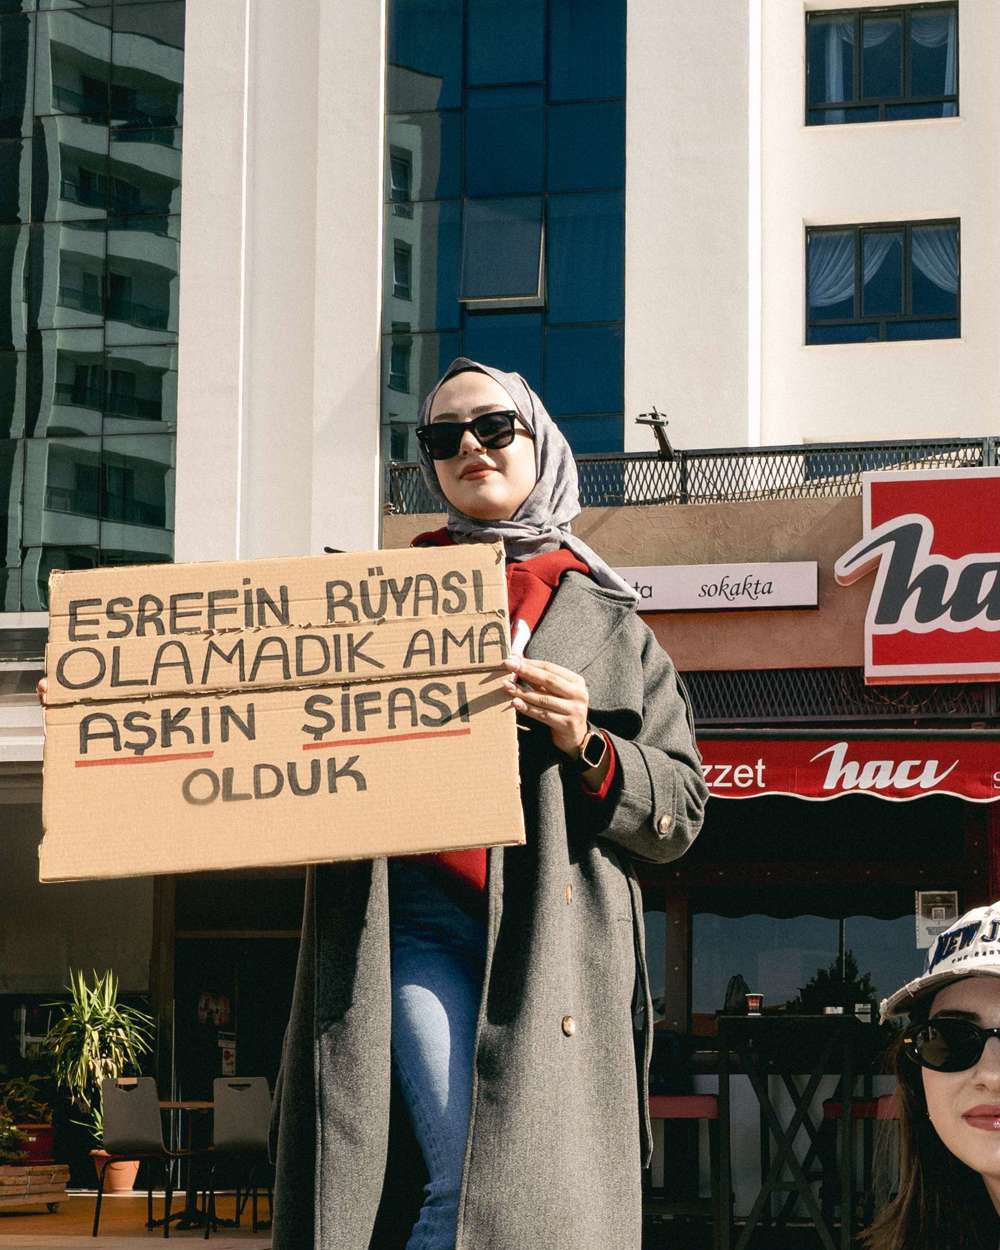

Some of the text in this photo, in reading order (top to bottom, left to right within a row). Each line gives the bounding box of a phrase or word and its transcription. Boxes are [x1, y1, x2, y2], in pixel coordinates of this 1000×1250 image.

[326, 567, 483, 623] RÜYASI
[698, 575, 774, 600] sokakta
[55, 621, 508, 690] OLAMADIK AMA
[79, 681, 470, 756] AŞKIN ŞİFASI
[182, 756, 367, 806] OLDUK
[809, 741, 959, 790] hacı
[929, 920, 982, 974] NEW
